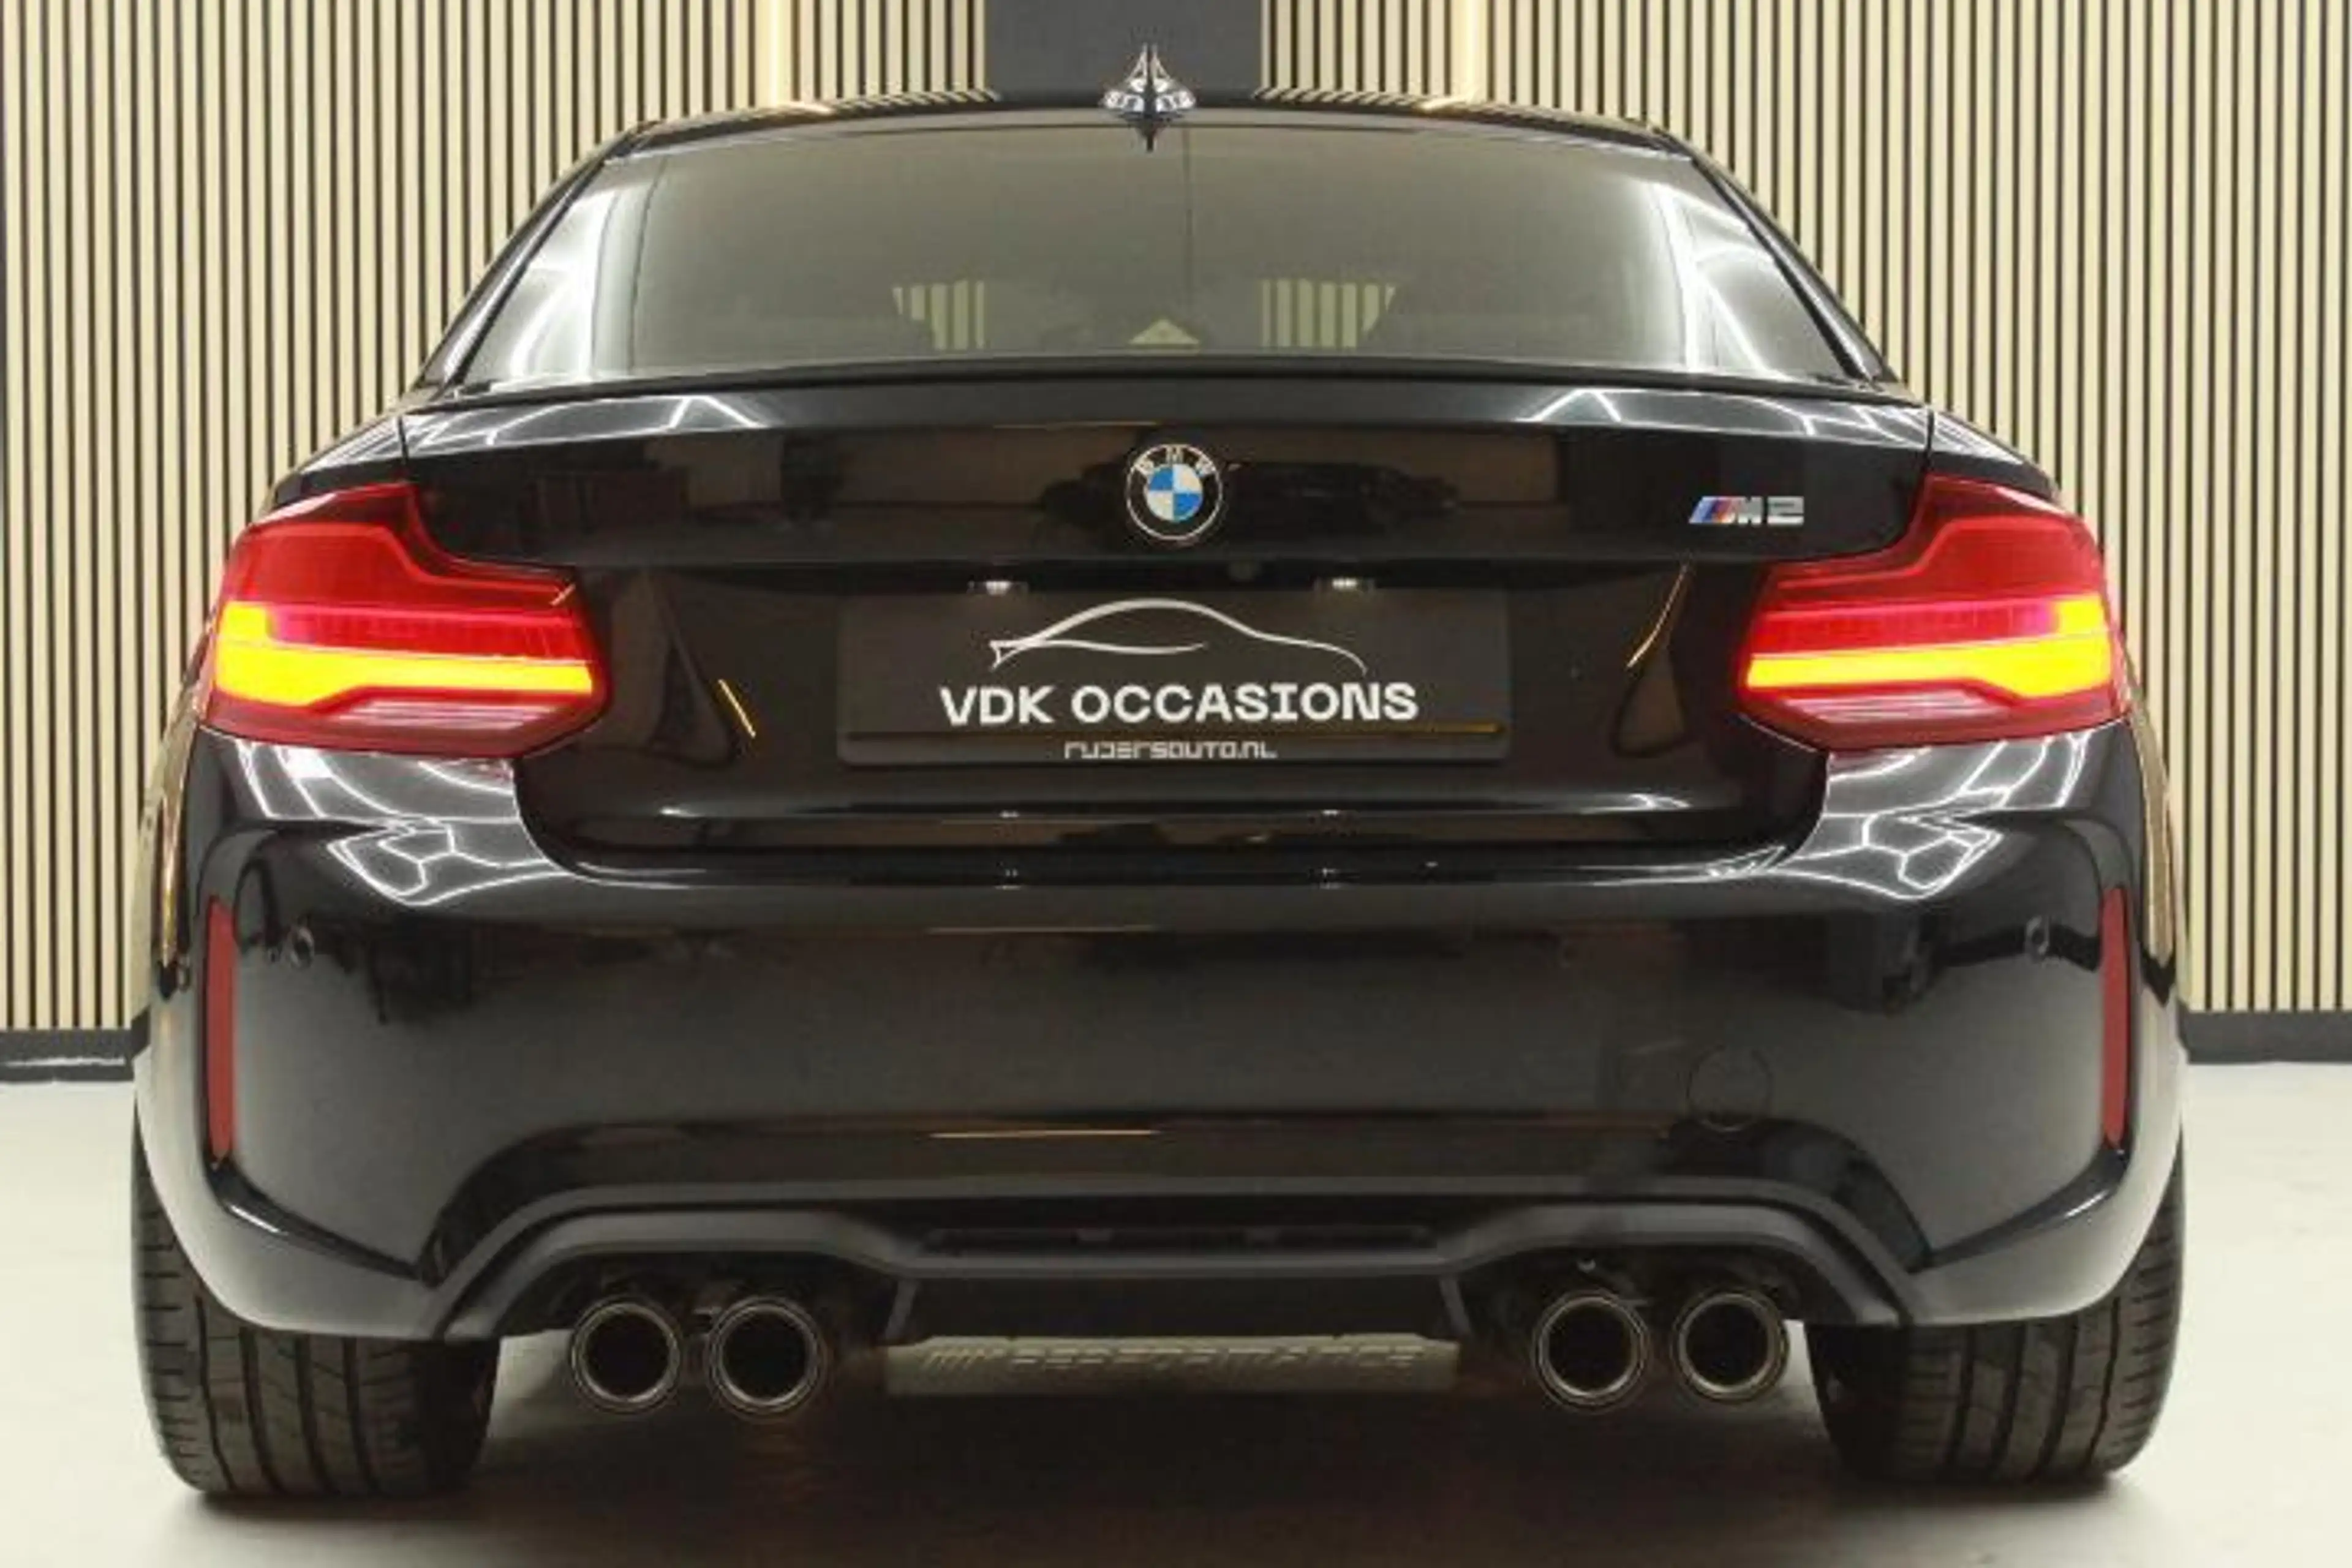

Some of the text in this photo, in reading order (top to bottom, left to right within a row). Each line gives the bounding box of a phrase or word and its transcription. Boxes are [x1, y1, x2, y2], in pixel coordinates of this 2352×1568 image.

[1133, 445, 1217, 478] BMW
[1719, 496, 1805, 525] M2
[939, 682, 1419, 726] VDK OCCASIONS
